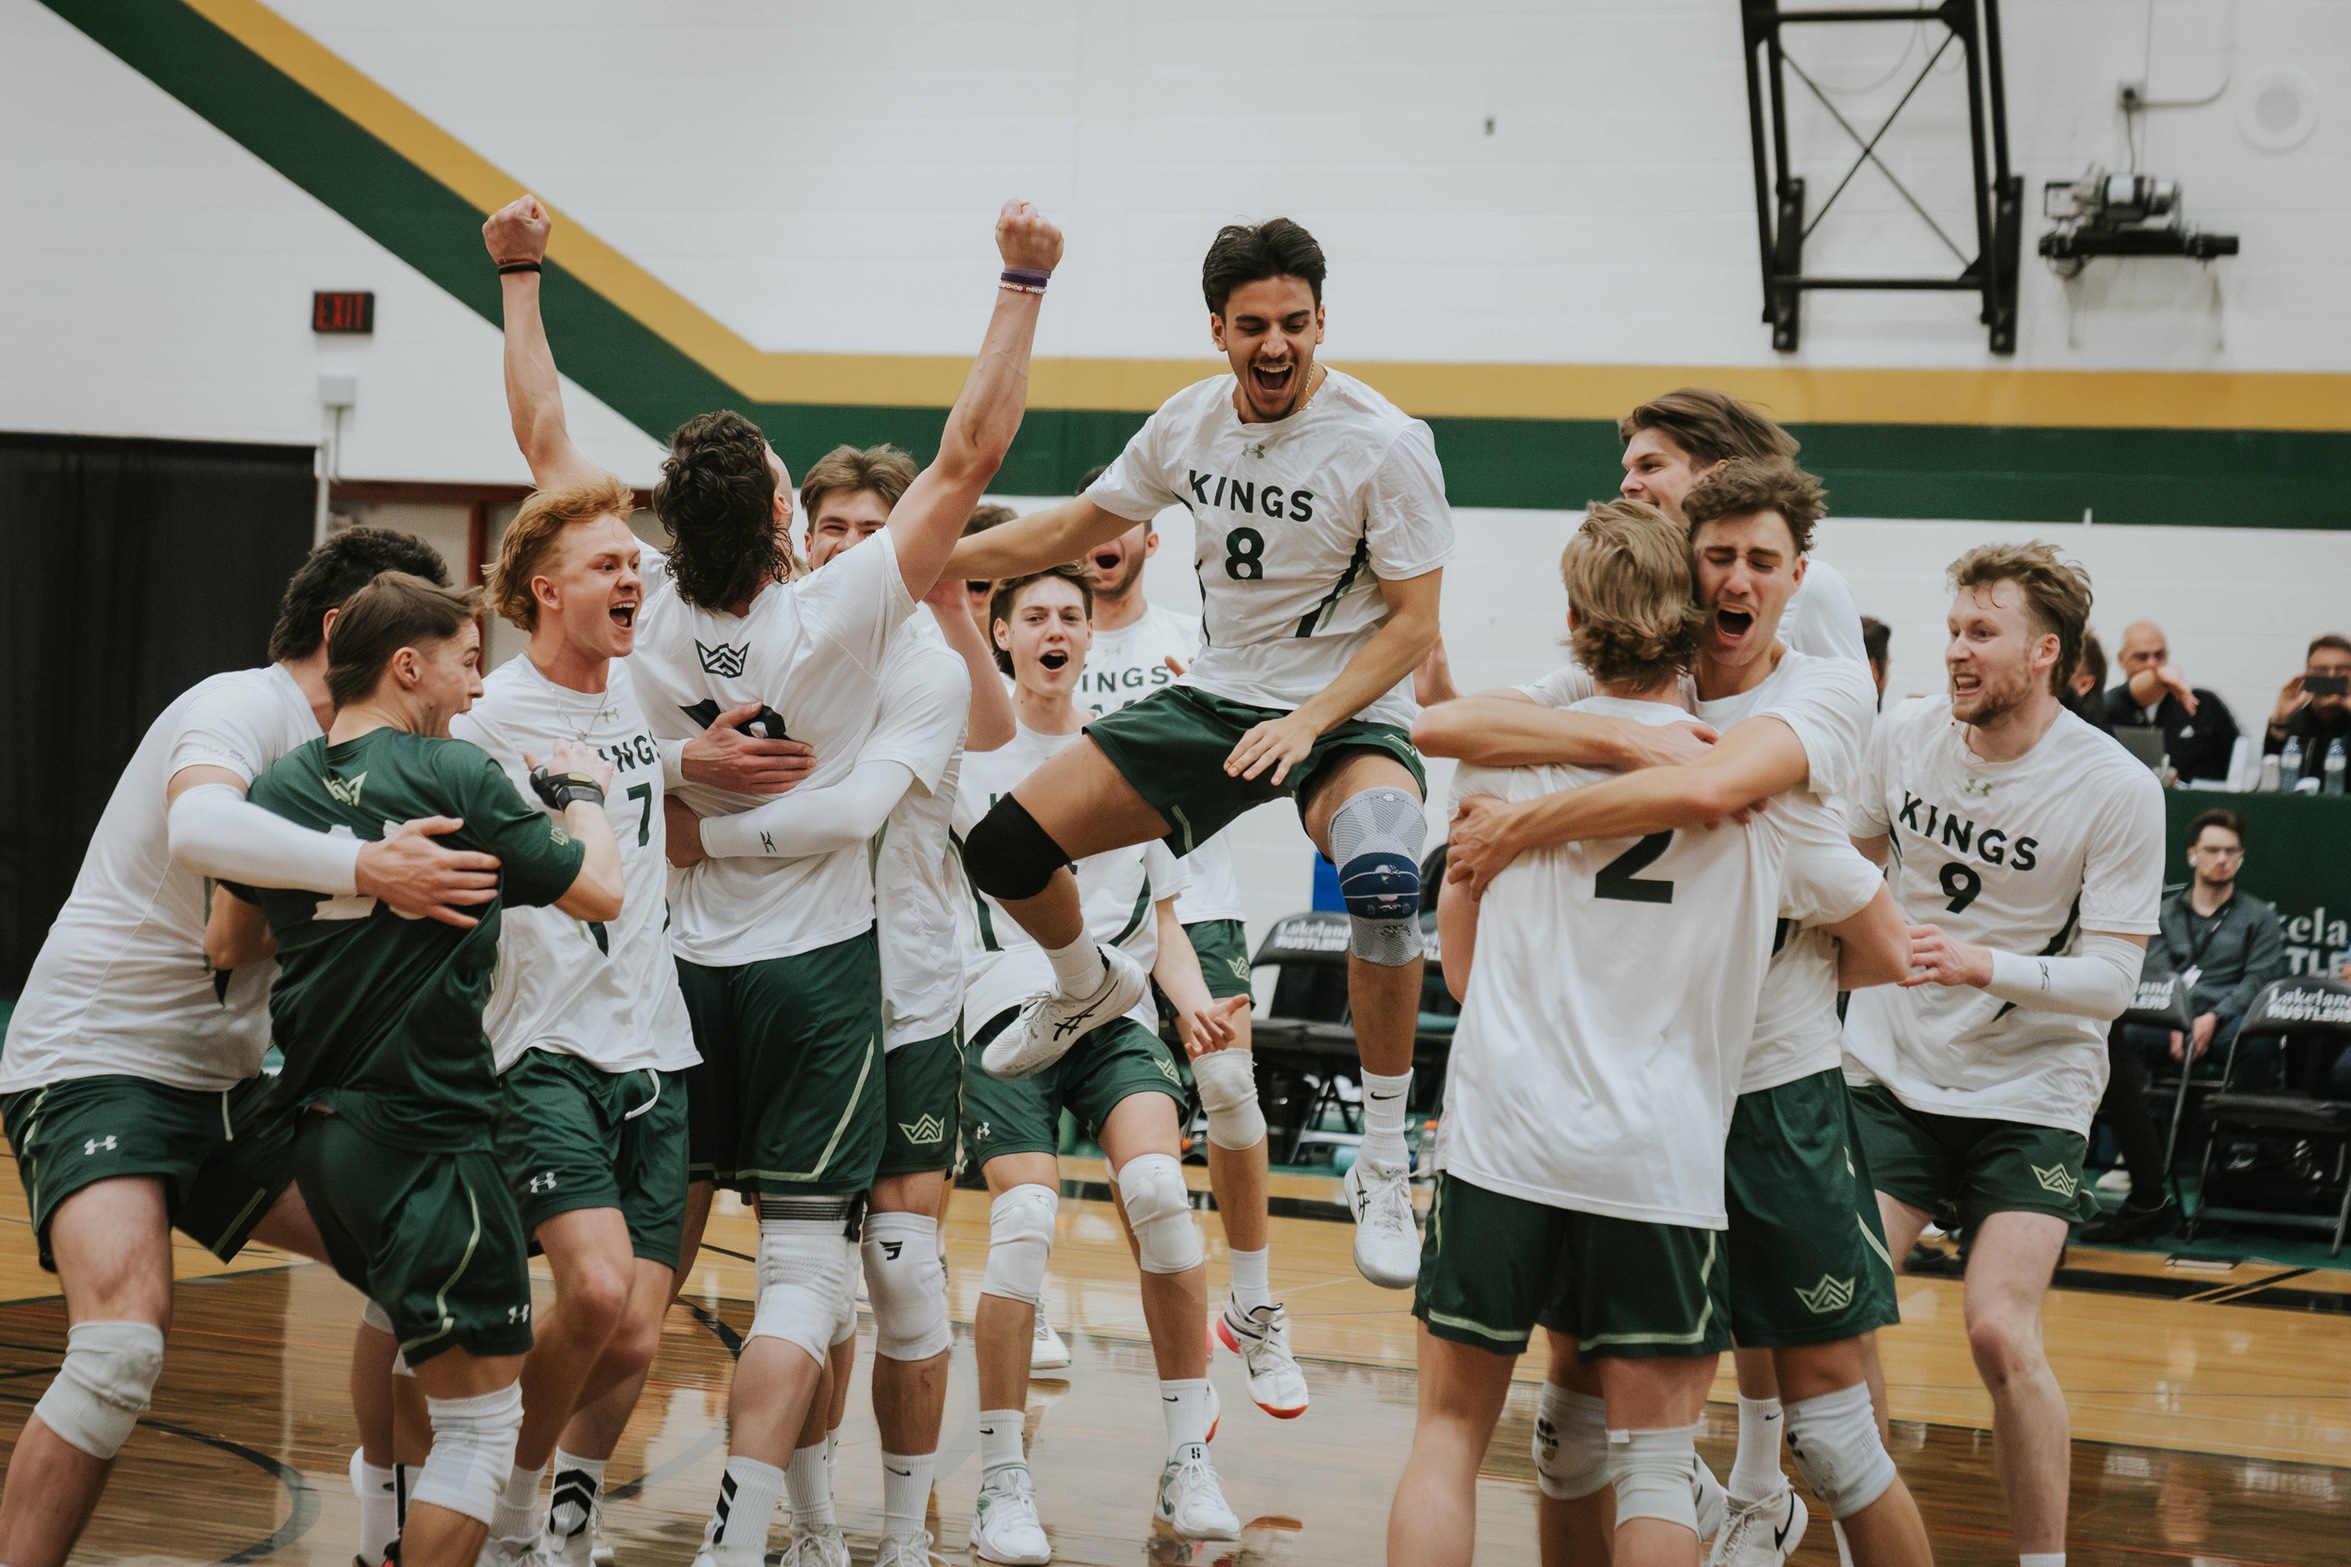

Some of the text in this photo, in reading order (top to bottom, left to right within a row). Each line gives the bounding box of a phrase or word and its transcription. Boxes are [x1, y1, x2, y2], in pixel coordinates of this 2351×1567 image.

[1189, 469, 1314, 522] KINGS
[1225, 527, 1265, 580] 8
[1082, 665, 1169, 693] INGS
[627, 782, 652, 847] 7
[1899, 790, 2039, 871] KINGS
[1594, 829, 1674, 904] 2
[1939, 861, 1981, 914] 9
